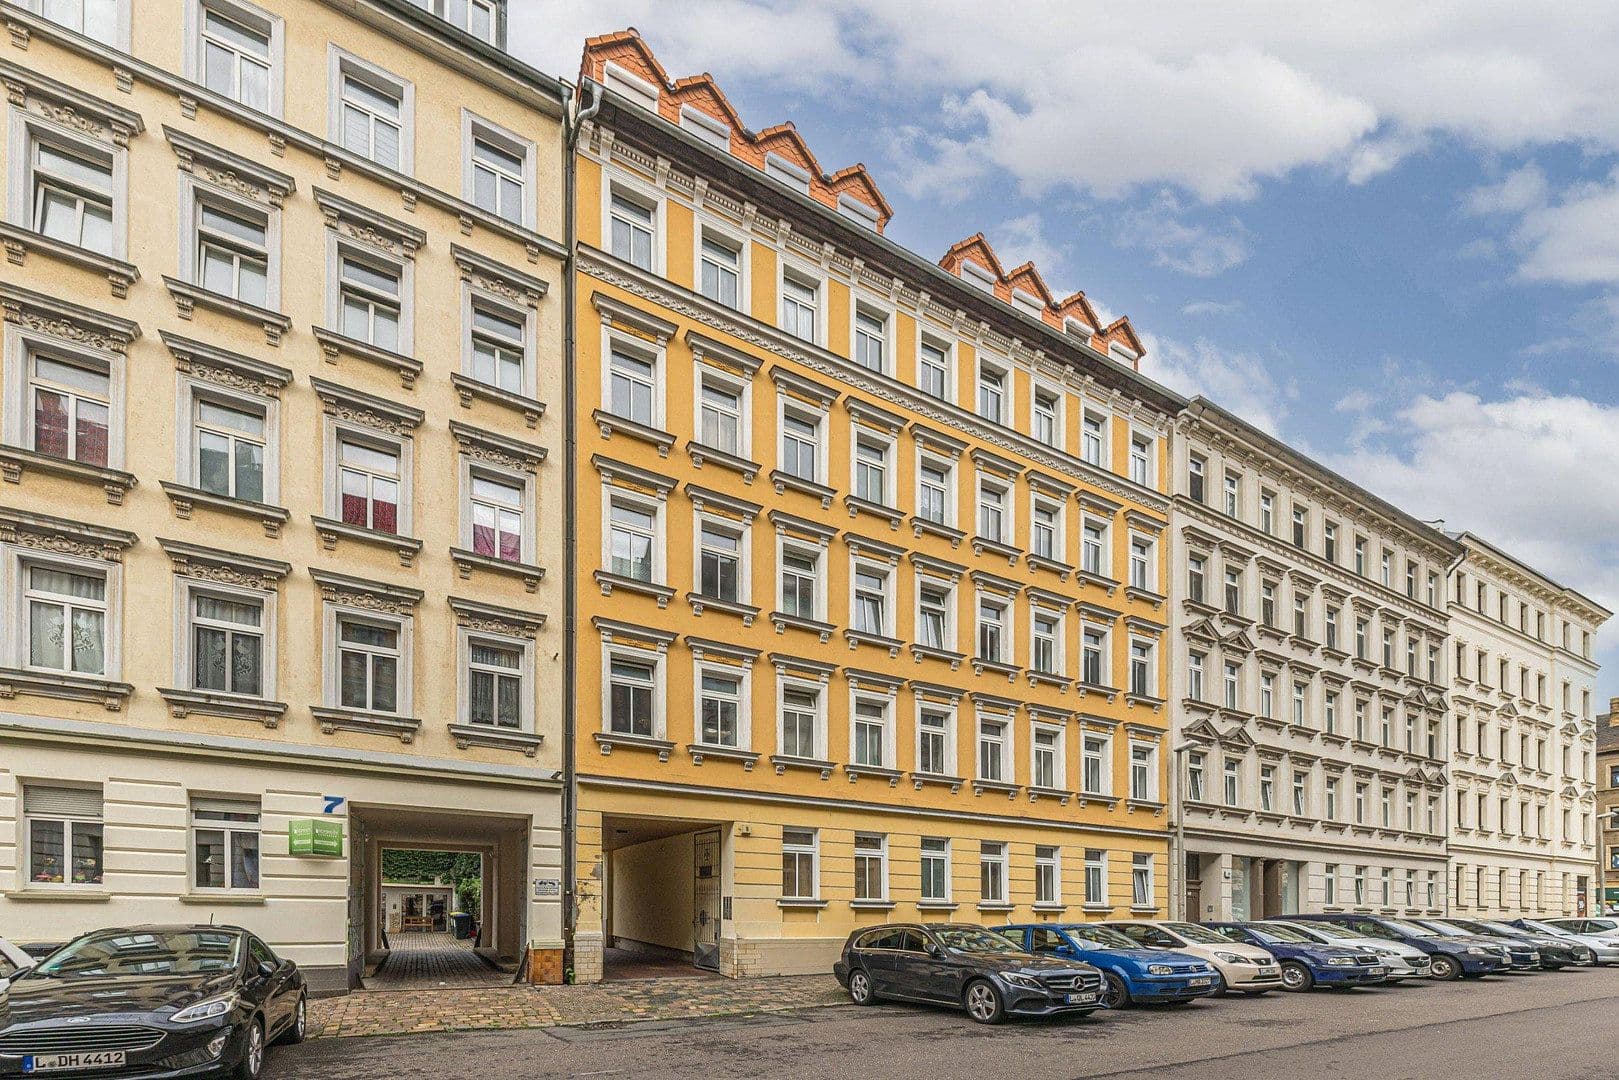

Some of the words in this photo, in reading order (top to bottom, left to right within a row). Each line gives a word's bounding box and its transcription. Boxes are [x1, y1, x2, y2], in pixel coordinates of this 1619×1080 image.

[324, 796, 344, 813] 7
[35, 1057, 46, 1068] L
[58, 1055, 79, 1067] DH
[83, 1052, 123, 1065] 4412
